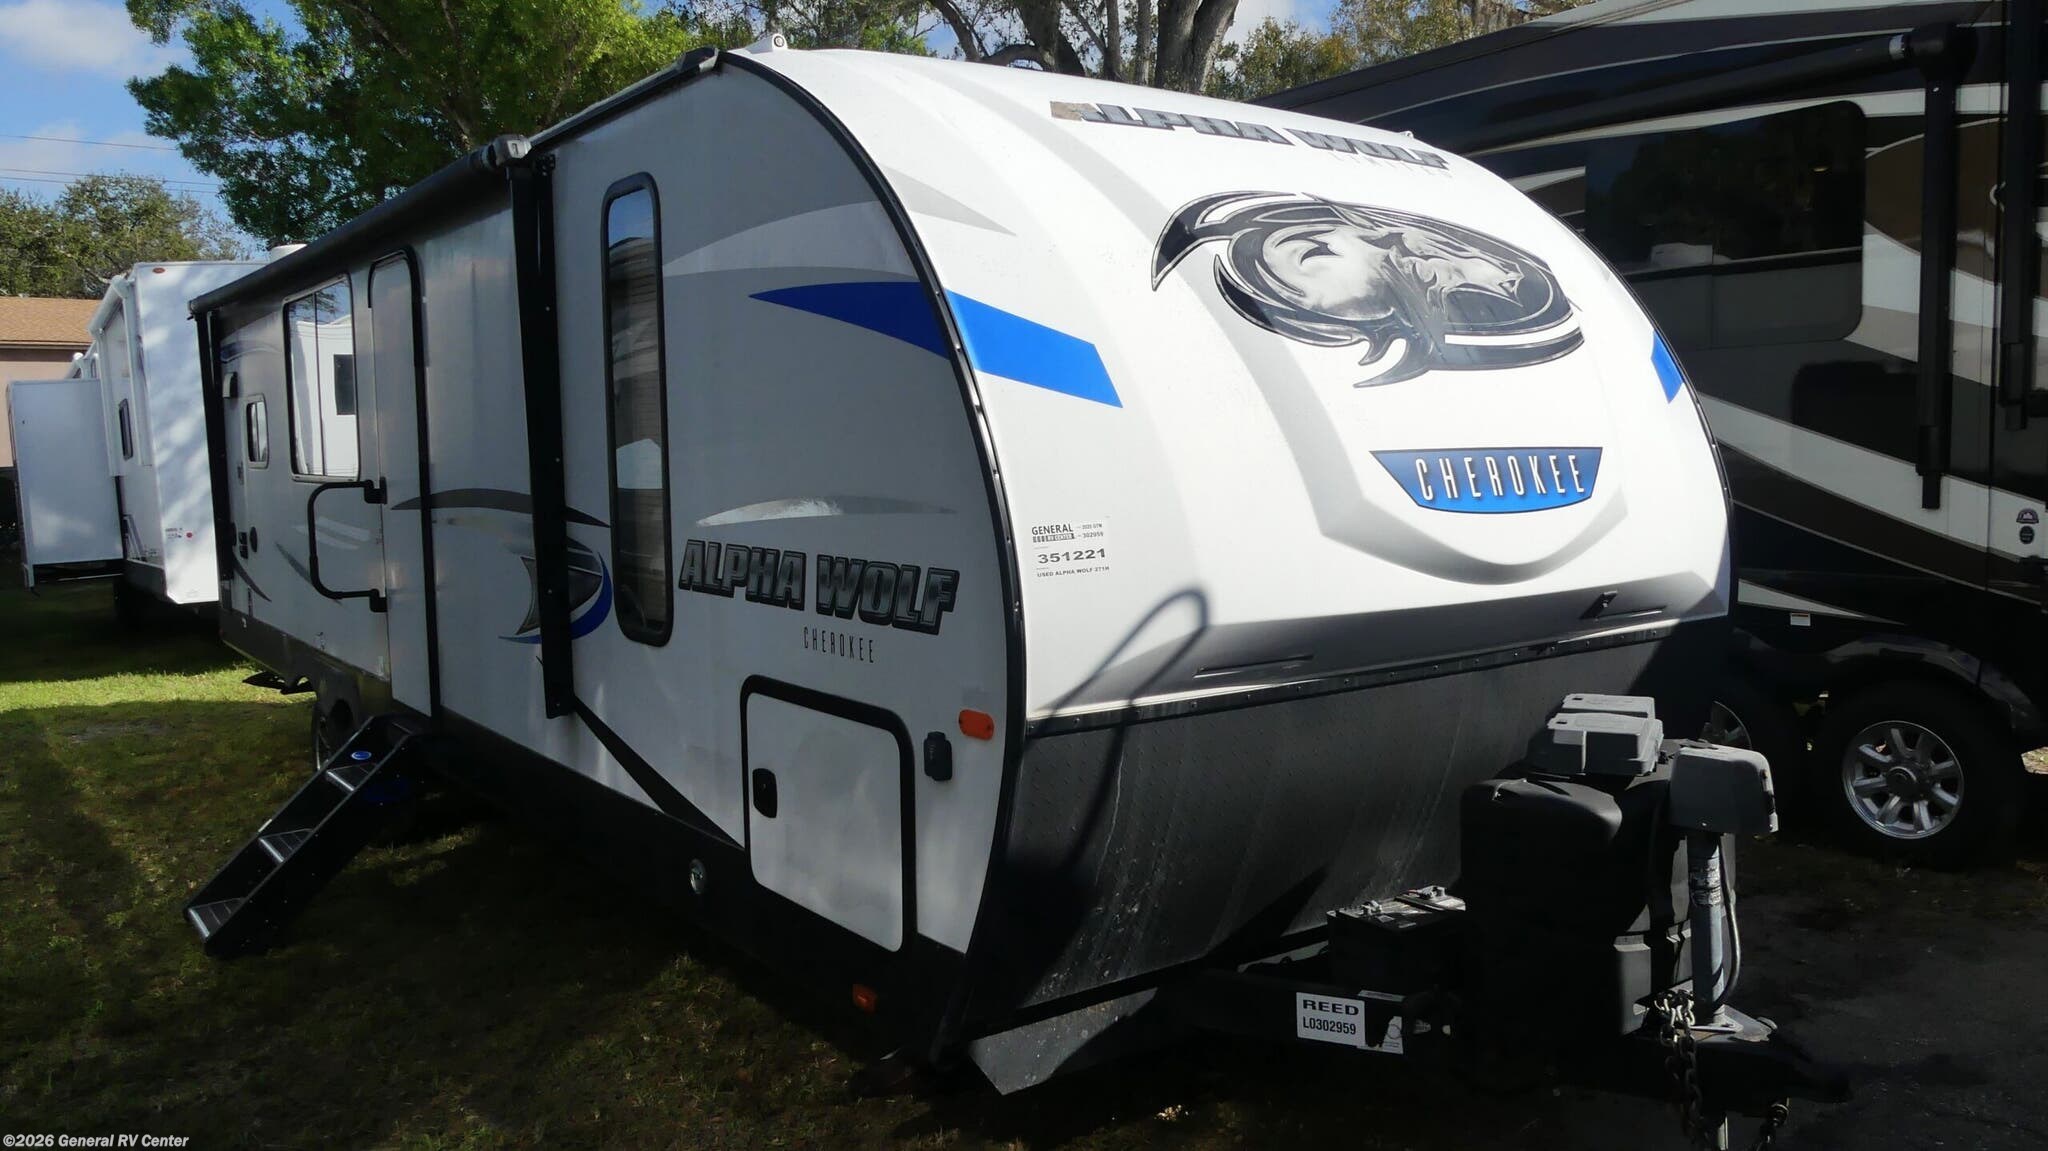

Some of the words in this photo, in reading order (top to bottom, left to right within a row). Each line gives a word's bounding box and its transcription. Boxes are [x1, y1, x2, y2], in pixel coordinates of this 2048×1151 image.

[1415, 454, 1585, 501] CHEROKEE
[1032, 524, 1073, 535] GENERAL
[1037, 548, 1106, 564] 351221
[679, 539, 806, 611] ALPHA
[816, 554, 960, 635] WOLF
[803, 627, 874, 663] CHEROKEE
[1303, 1000, 1359, 1015] REED
